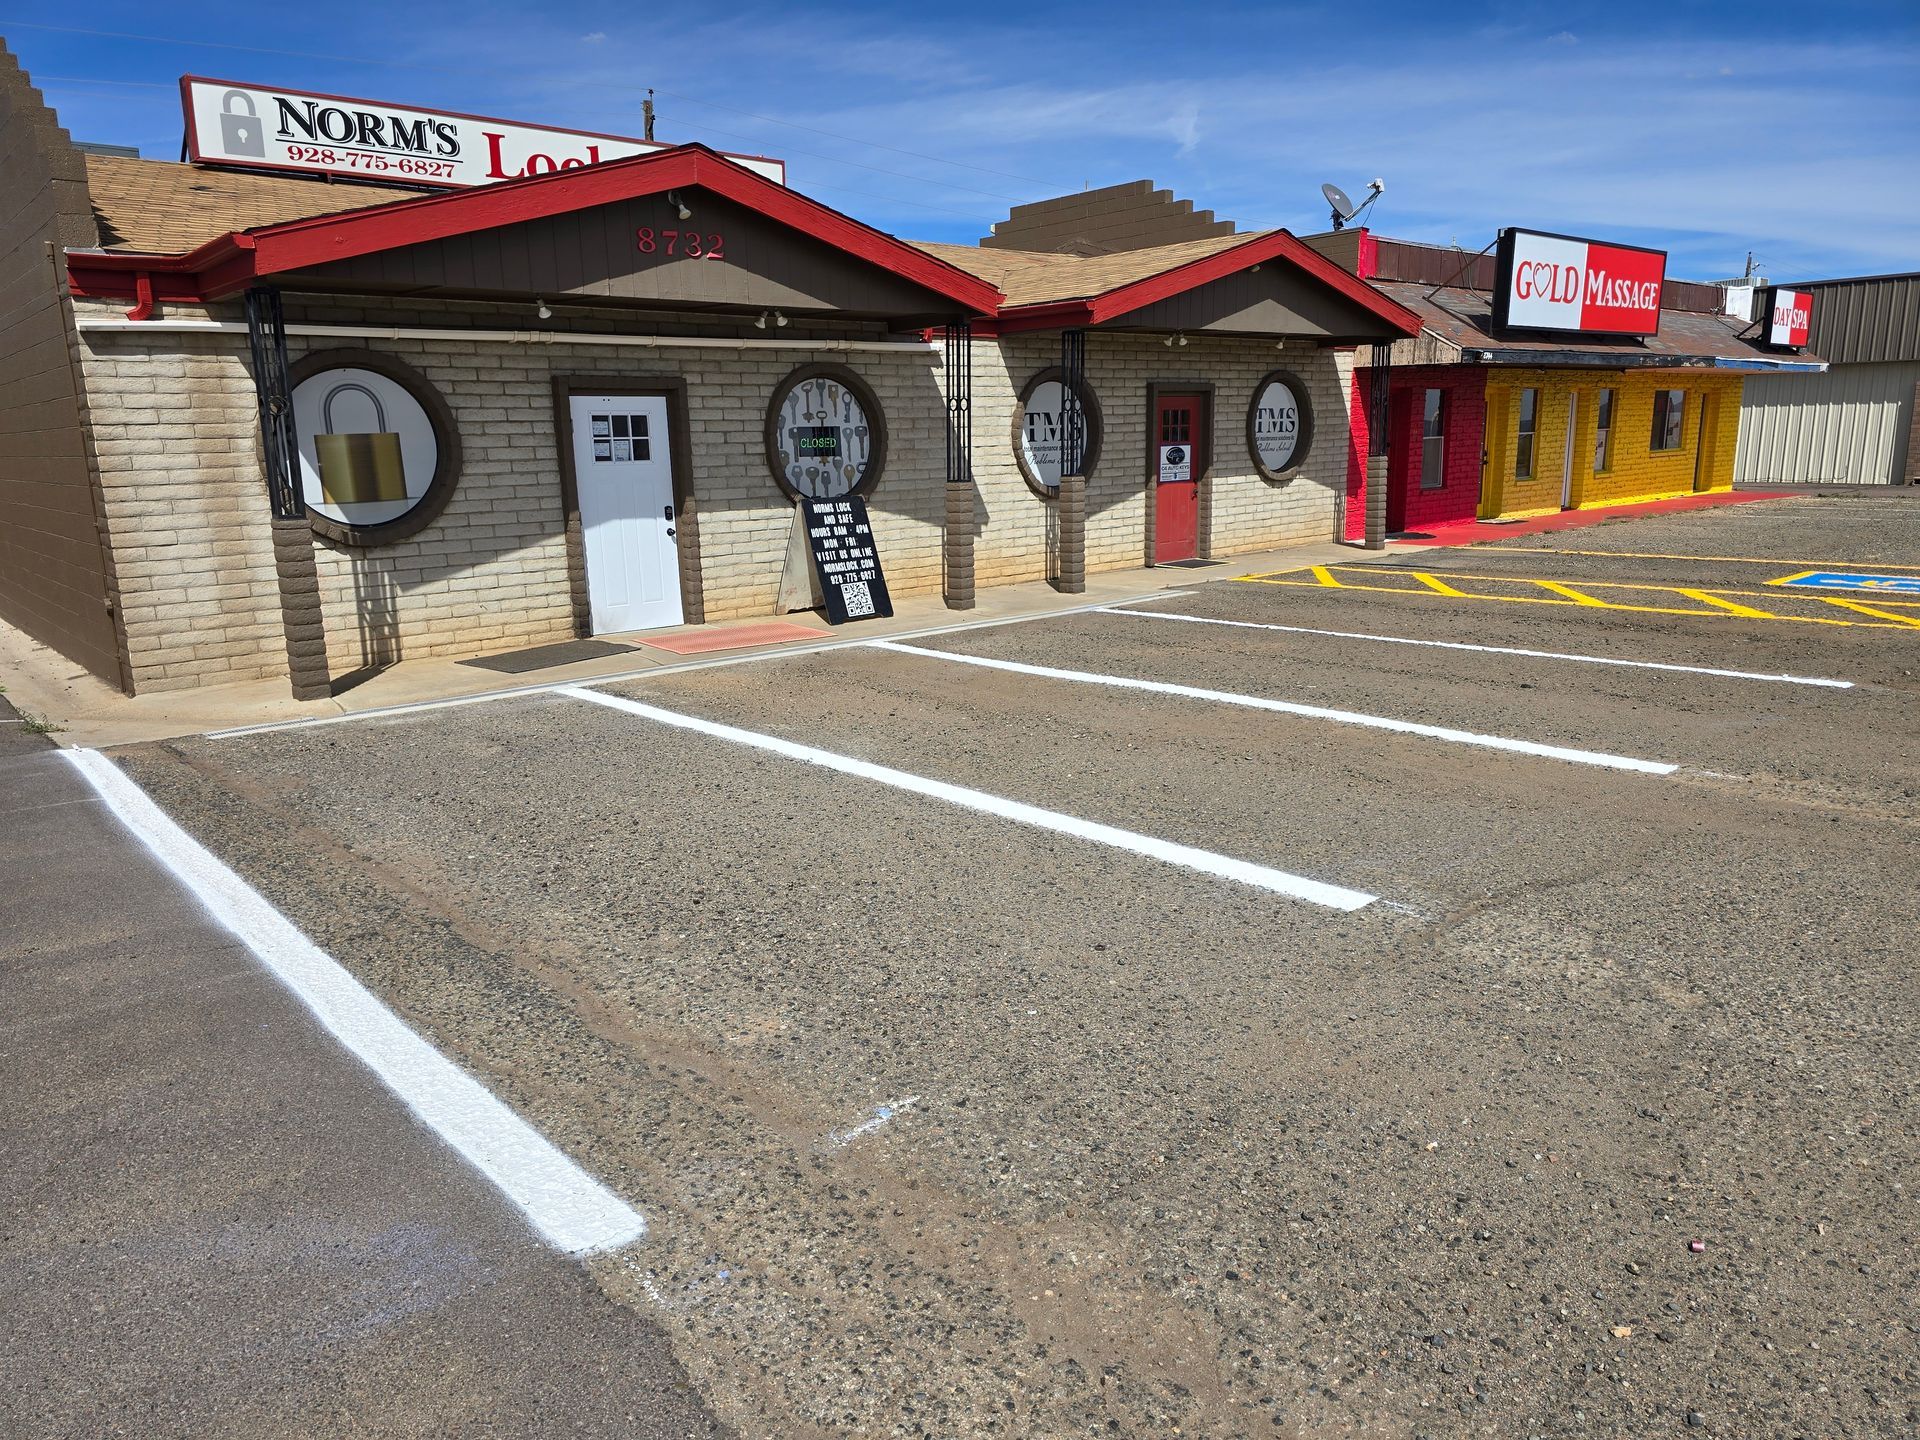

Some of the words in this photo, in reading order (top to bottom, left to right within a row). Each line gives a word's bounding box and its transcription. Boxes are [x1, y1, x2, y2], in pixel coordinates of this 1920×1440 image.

[272, 96, 461, 158] NORM'S
[286, 145, 456, 178] 928-775-6827
[636, 226, 725, 260] 8732
[1585, 269, 1659, 310] MASSAGE
[1773, 306, 1792, 327] DAY
[1791, 308, 1808, 330] SPA
[1256, 407, 1296, 433] TMS
[800, 437, 837, 448] CLOSED
[813, 503, 834, 514] NORMS
[836, 502, 852, 512] LOCK
[823, 515, 836, 525] AND
[838, 514, 854, 524] SAFE
[810, 527, 831, 538] HOURS
[833, 526, 848, 536] 8AM
[855, 524, 869, 534] 4PM
[823, 539, 838, 549] MON
[816, 551, 837, 561] VISIT
[839, 549, 848, 559] US
[850, 547, 874, 558] ONLINE
